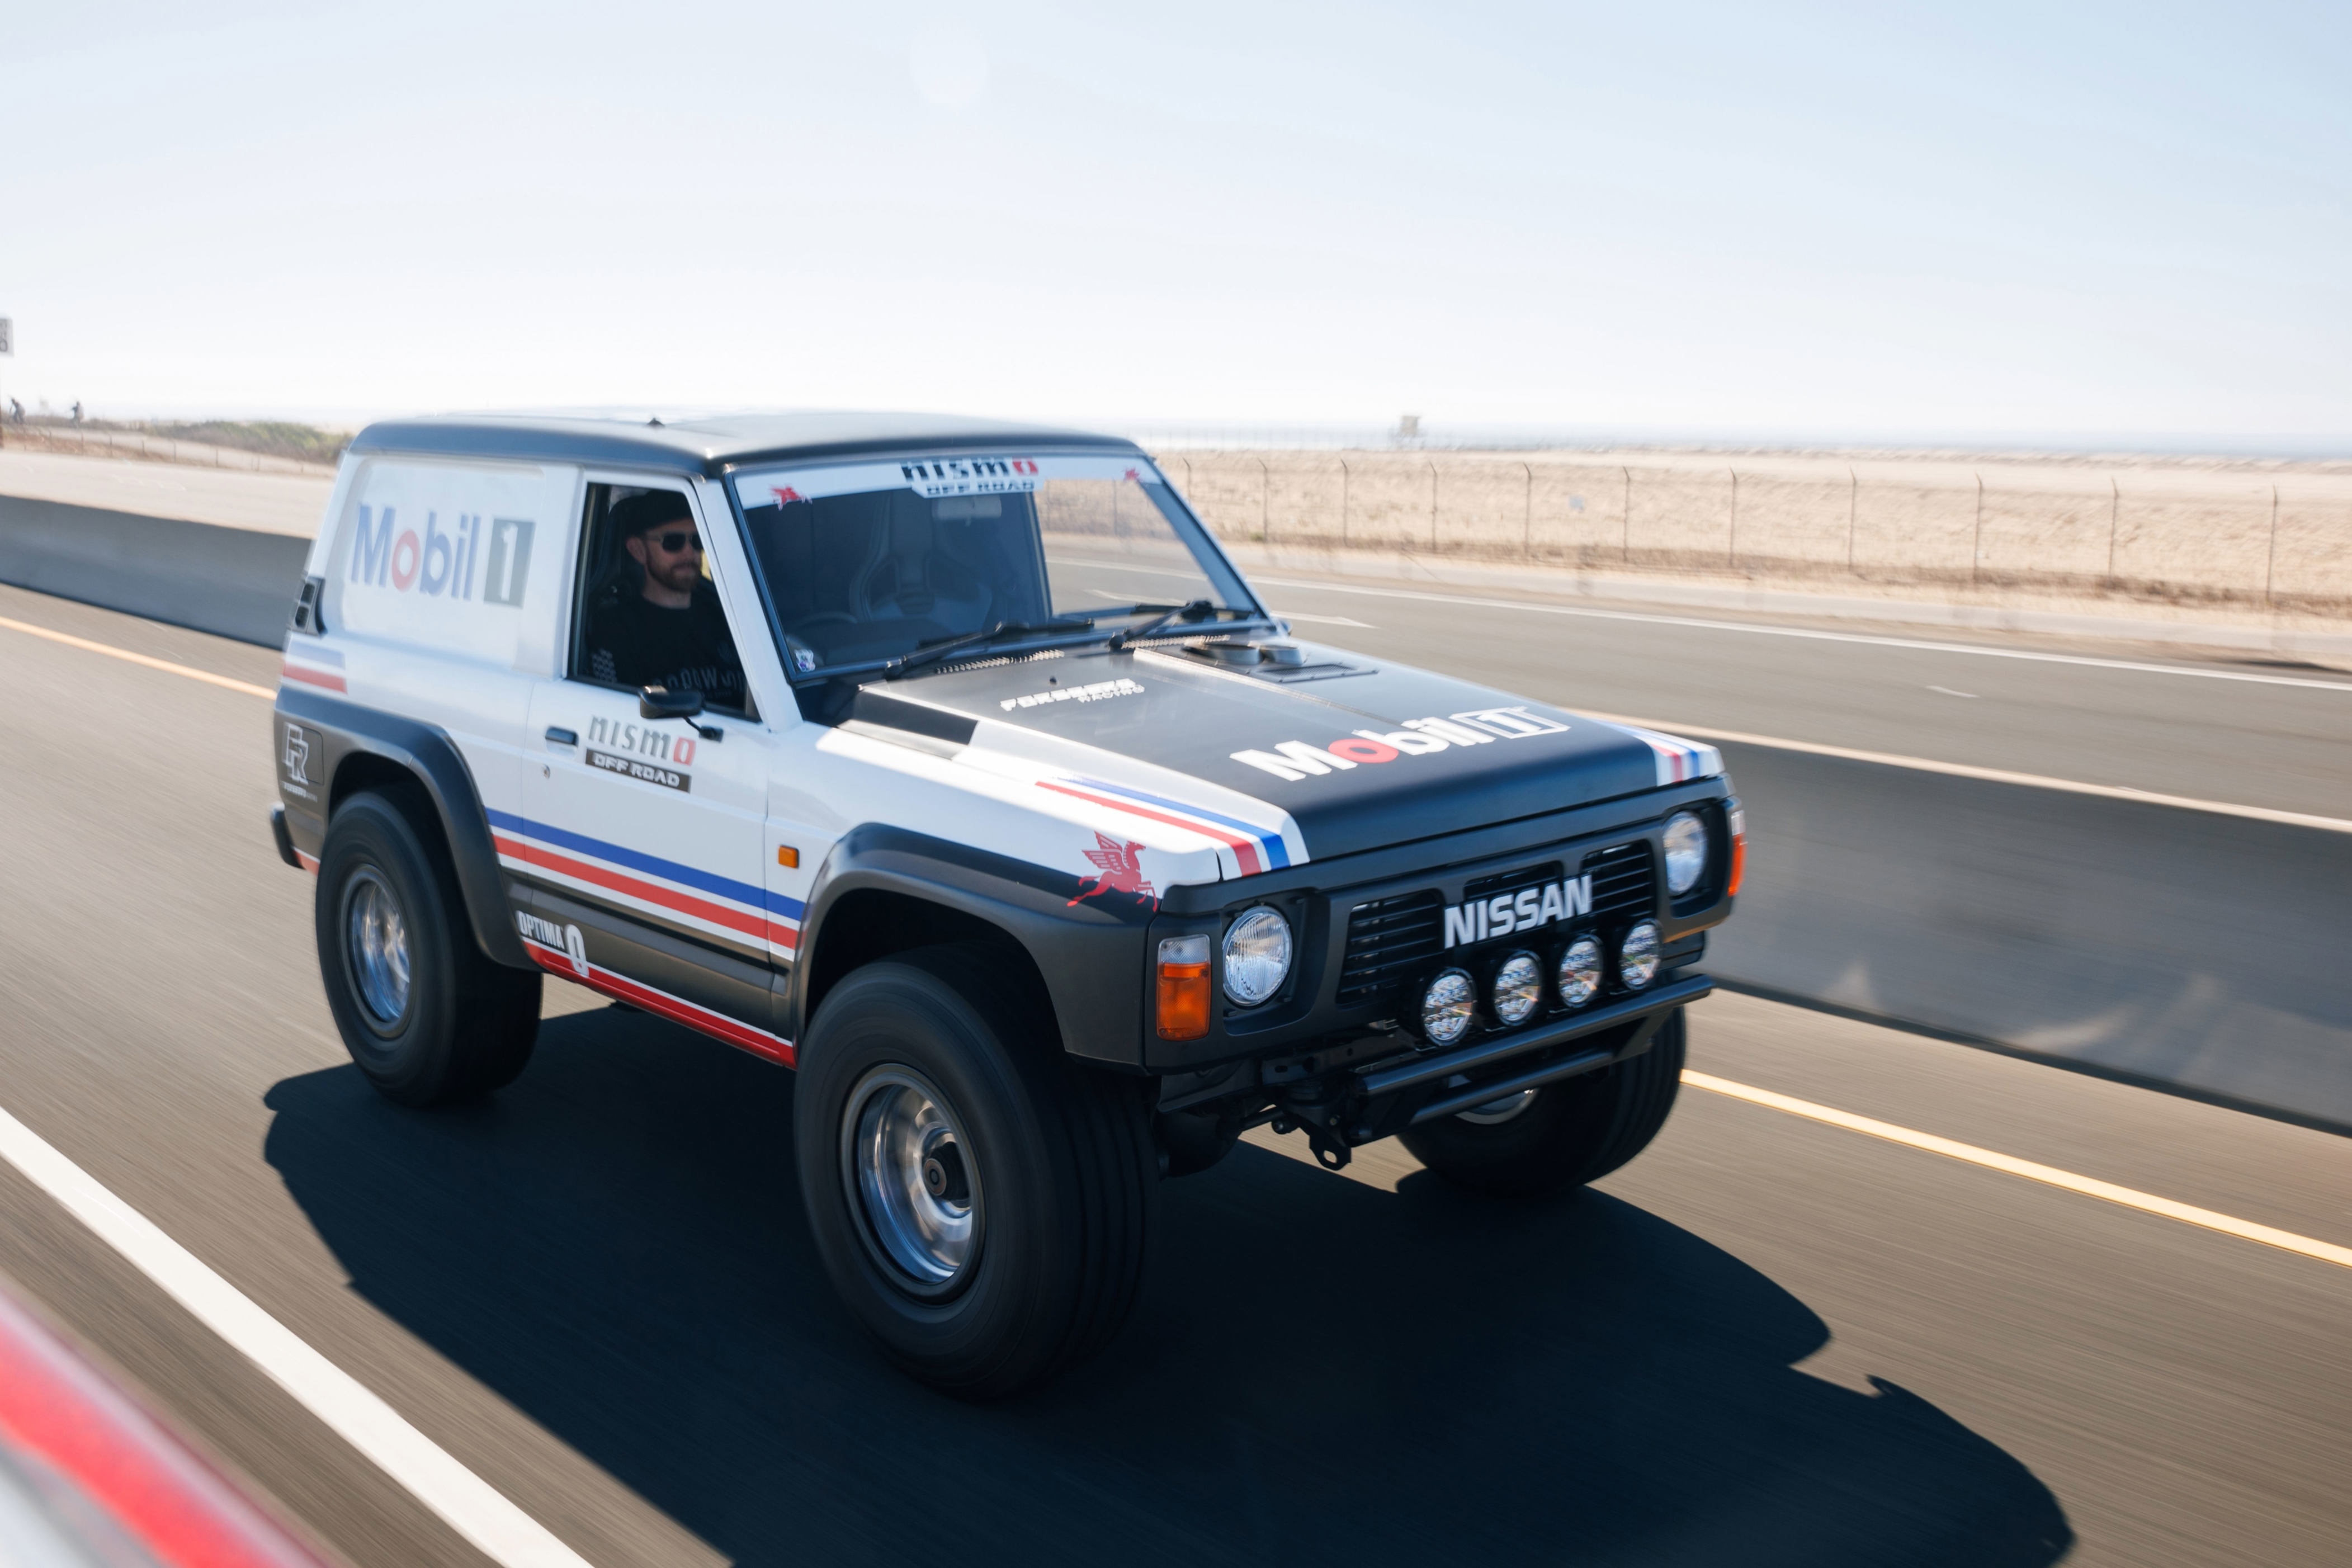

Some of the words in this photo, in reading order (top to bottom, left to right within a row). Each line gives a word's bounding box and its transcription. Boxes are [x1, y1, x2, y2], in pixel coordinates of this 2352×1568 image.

[925, 481, 970, 495] OFF
[976, 478, 1035, 492] ROAD
[350, 503, 481, 602] Mobil
[592, 750, 630, 772] OFF
[629, 762, 680, 788] ROAD
[1230, 716, 1498, 781] Mobil
[516, 910, 565, 950] OPTIMA
[1444, 874, 1593, 949] NISSAN
